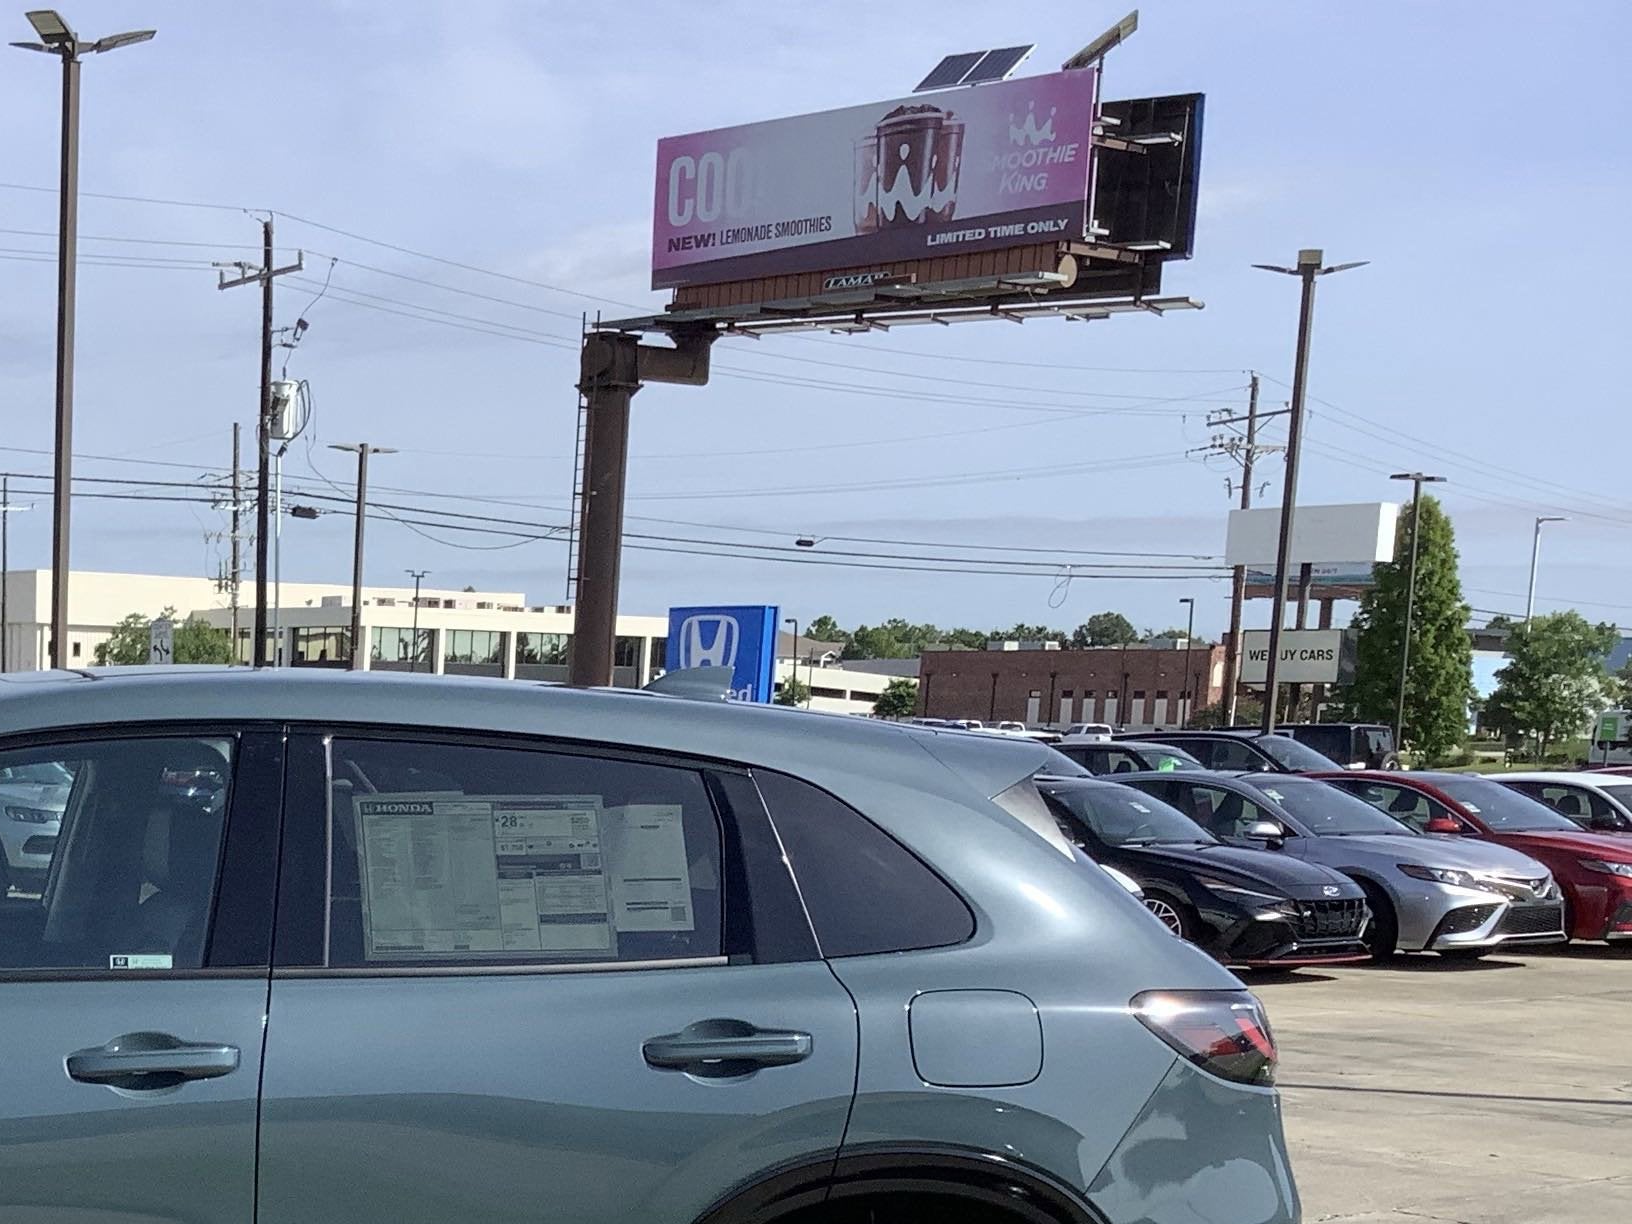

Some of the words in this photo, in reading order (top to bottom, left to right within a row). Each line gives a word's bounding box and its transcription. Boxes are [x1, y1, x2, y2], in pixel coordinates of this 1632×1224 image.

[984, 143, 1079, 173] MOOTHIE
[668, 232, 716, 253] NEW!
[719, 224, 772, 246] LEMONADE
[774, 215, 832, 239] SMOOTHIES
[927, 228, 986, 246] LIMITED
[988, 223, 1025, 239] TIME
[1027, 218, 1068, 234] ONLY
[1249, 649, 1268, 661] WE
[1274, 649, 1297, 661] UY
[1299, 649, 1334, 661] CARS
[375, 803, 432, 813] HONDA
[500, 815, 518, 828] 28
